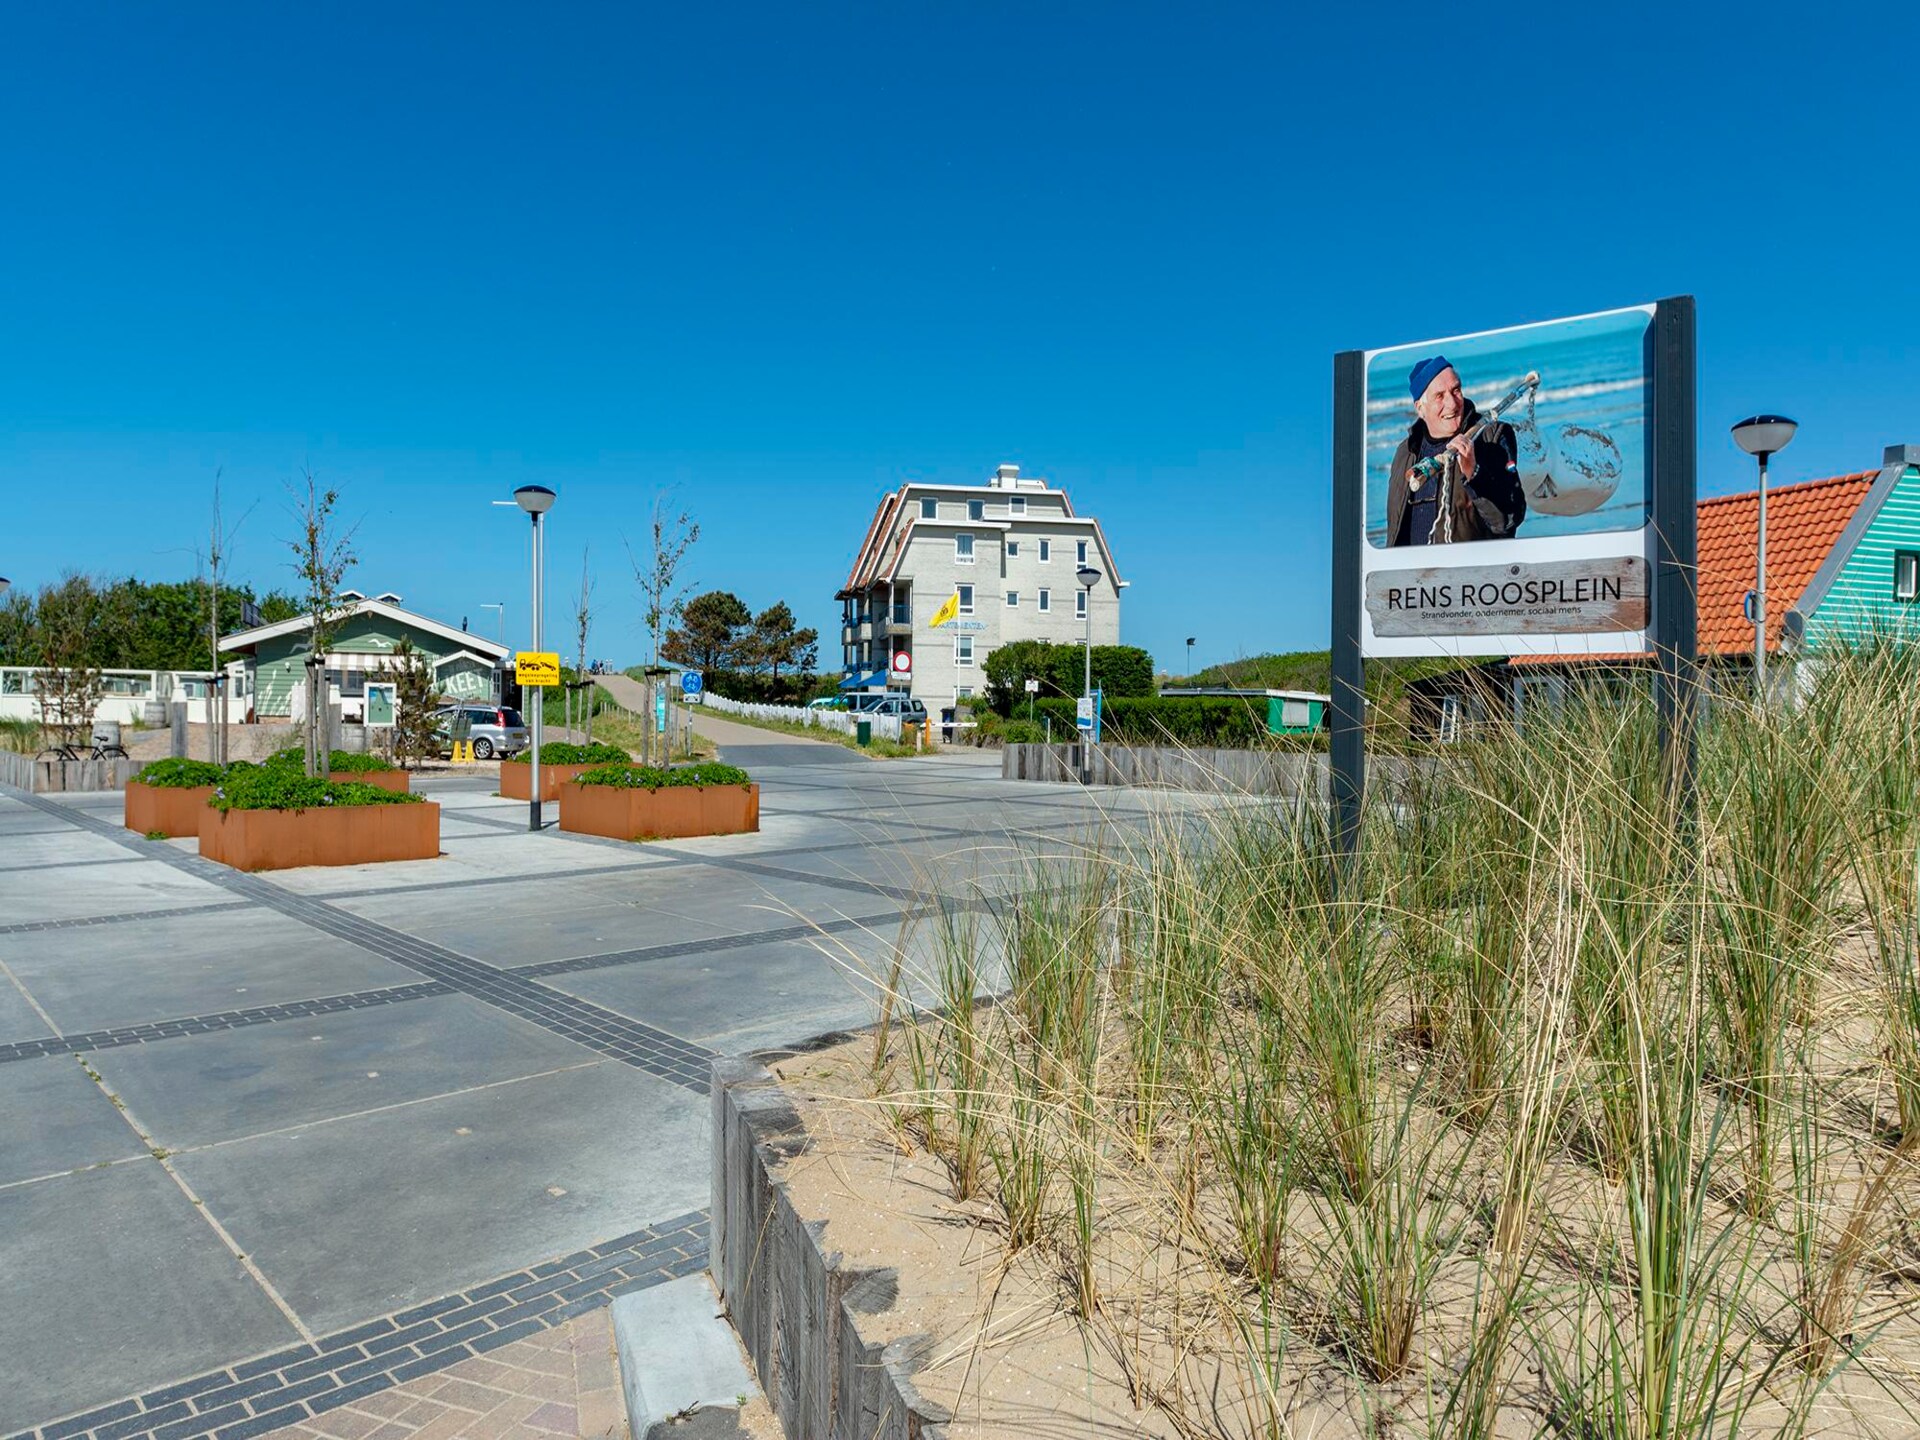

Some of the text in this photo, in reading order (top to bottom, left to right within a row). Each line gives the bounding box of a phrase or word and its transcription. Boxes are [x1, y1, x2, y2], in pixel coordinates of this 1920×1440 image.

[1388, 577, 1622, 610] RENS ROOSPLEIN
[1421, 606, 1582, 619] Strandvonder, ondernemer, sociaal mens
[444, 668, 484, 694] KEET
